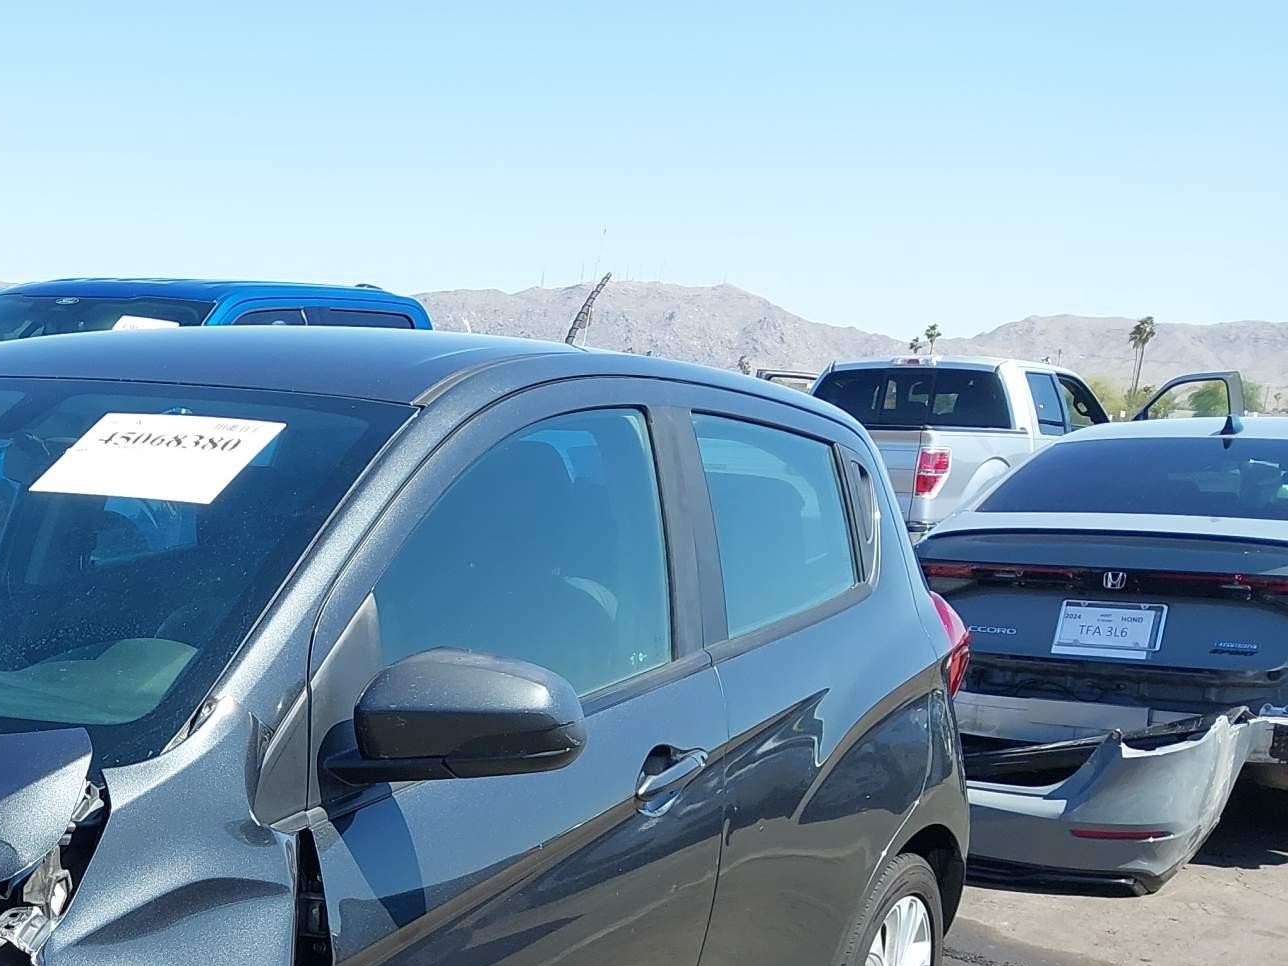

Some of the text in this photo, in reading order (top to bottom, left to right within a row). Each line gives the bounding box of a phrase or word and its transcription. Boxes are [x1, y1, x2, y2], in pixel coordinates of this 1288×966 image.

[98, 431, 242, 452] 45068380
[1121, 615, 1144, 624] HOND
[967, 625, 1017, 635] CCORD
[1079, 624, 1128, 638] TFA 3L6
